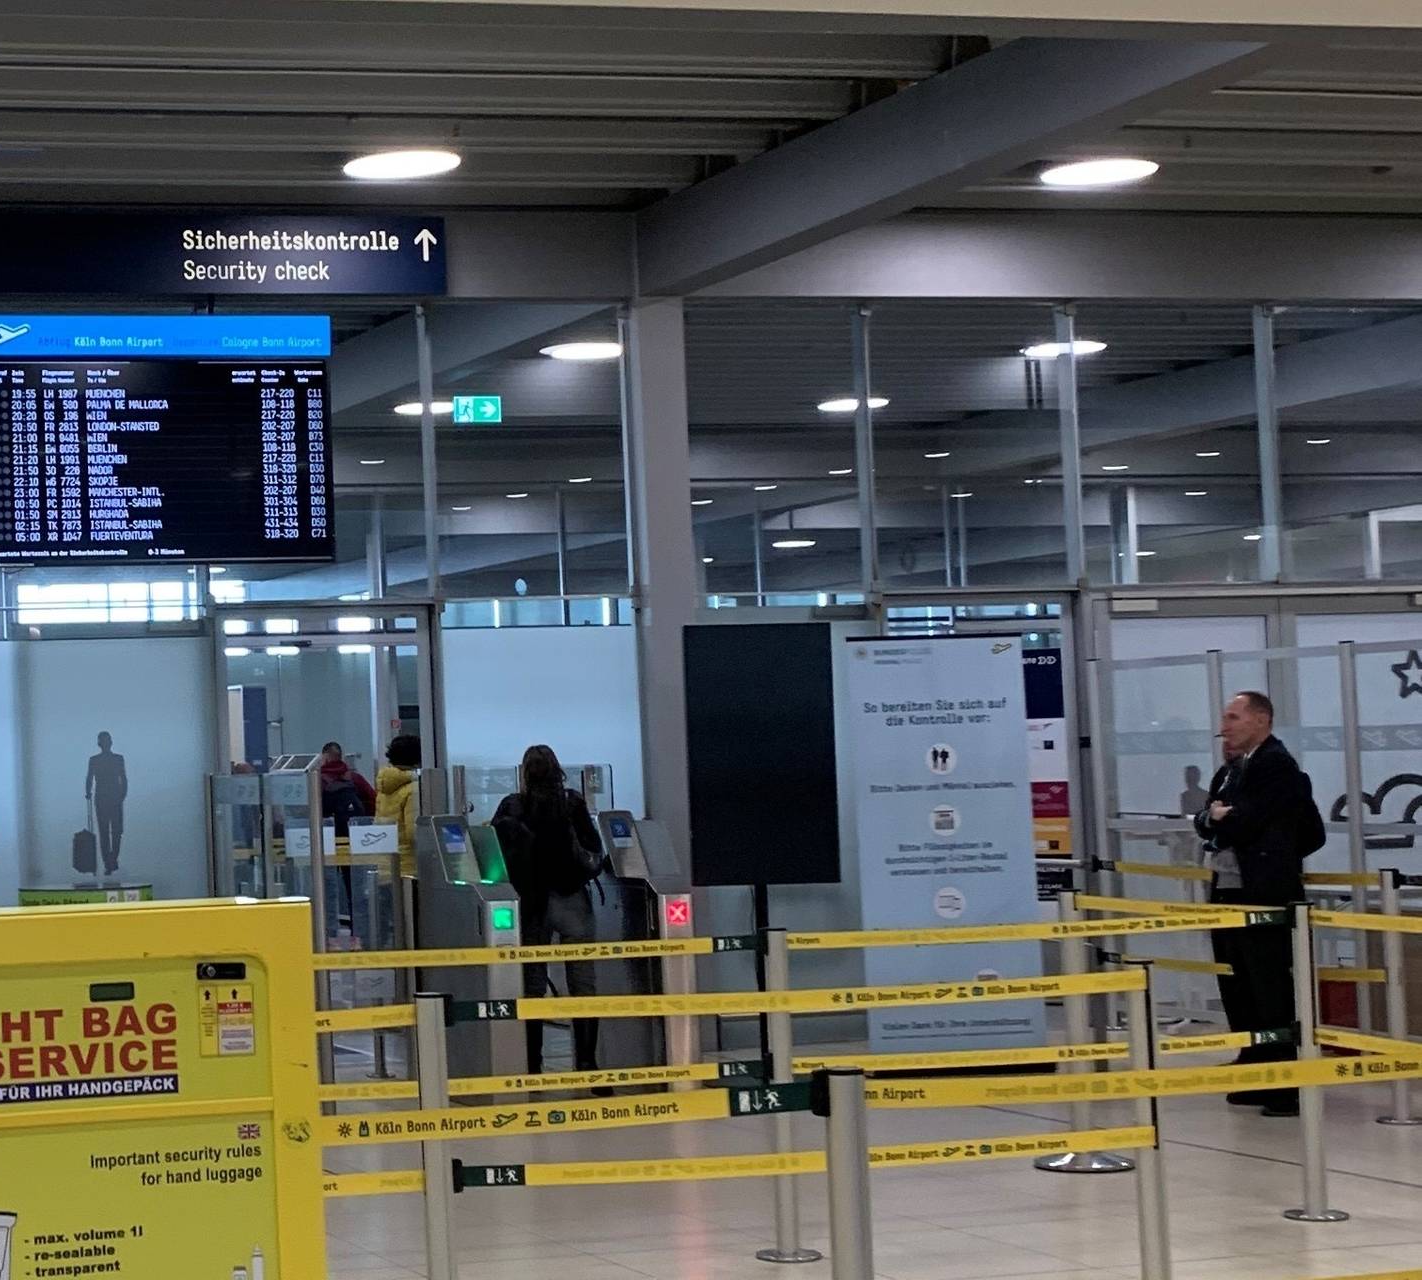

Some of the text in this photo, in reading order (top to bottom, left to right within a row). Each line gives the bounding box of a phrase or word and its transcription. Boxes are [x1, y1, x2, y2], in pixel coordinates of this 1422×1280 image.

[182, 230, 399, 250] Sicherheitskontrolle
[183, 260, 330, 283] Security check
[74, 336, 96, 346] Köln
[100, 337, 123, 346] Bonn
[127, 336, 163, 347] Airport
[222, 337, 258, 348] Cologne
[262, 337, 284, 347] Bonn
[287, 337, 322, 348] Airport
[12, 389, 125, 398] 19:55 MUENCHEN
[12, 400, 168, 409] 20:05 PALMA DE MALLORCA
[12, 411, 107, 420] 20:20 WIEN
[12, 422, 159, 431] 20:50 LONDON-STANSTED
[13, 433, 107, 442] 21:00 WIEN
[13, 444, 117, 453] 21:15 BERLIN
[13, 455, 127, 464] 21:20 MUENCHEN
[14, 466, 113, 475] 21:50 NADOR
[14, 476, 118, 486] 22:10 SKOPJE
[14, 487, 164, 497] 23:00 MANCHESTER-INTL.
[15, 498, 162, 508] 00:50 ISTANBUL-SABIHA
[15, 509, 129, 519] 01:50 HURGHADA
[15, 520, 162, 530] 02:15 ISTANBUL-SABIHA
[16, 531, 153, 541] 05:00 FUERTEVENTURA
[864, 697, 1006, 713] So bereiten Sie sich auf
[886, 716, 903, 726] die
[909, 714, 964, 724] Kontrolle
[82, 1003, 177, 1039] BAG
[1368, 1060, 1419, 1073] Köln Bonn
[35, 1084, 62, 1098] IHR
[68, 1077, 174, 1096] HANDGEPÄCK
[882, 1087, 926, 1101] Airport
[571, 1101, 679, 1122] Köln Bonn Airport
[375, 1115, 486, 1136] Köln Bonn Airport
[90, 1144, 261, 1170] Important security rules
[141, 1165, 262, 1185] for hand luggage
[34, 1235, 69, 1245] max.
[74, 1230, 125, 1241] volume
[35, 1244, 115, 1261] re-sealable
[35, 1260, 120, 1277] transparent
